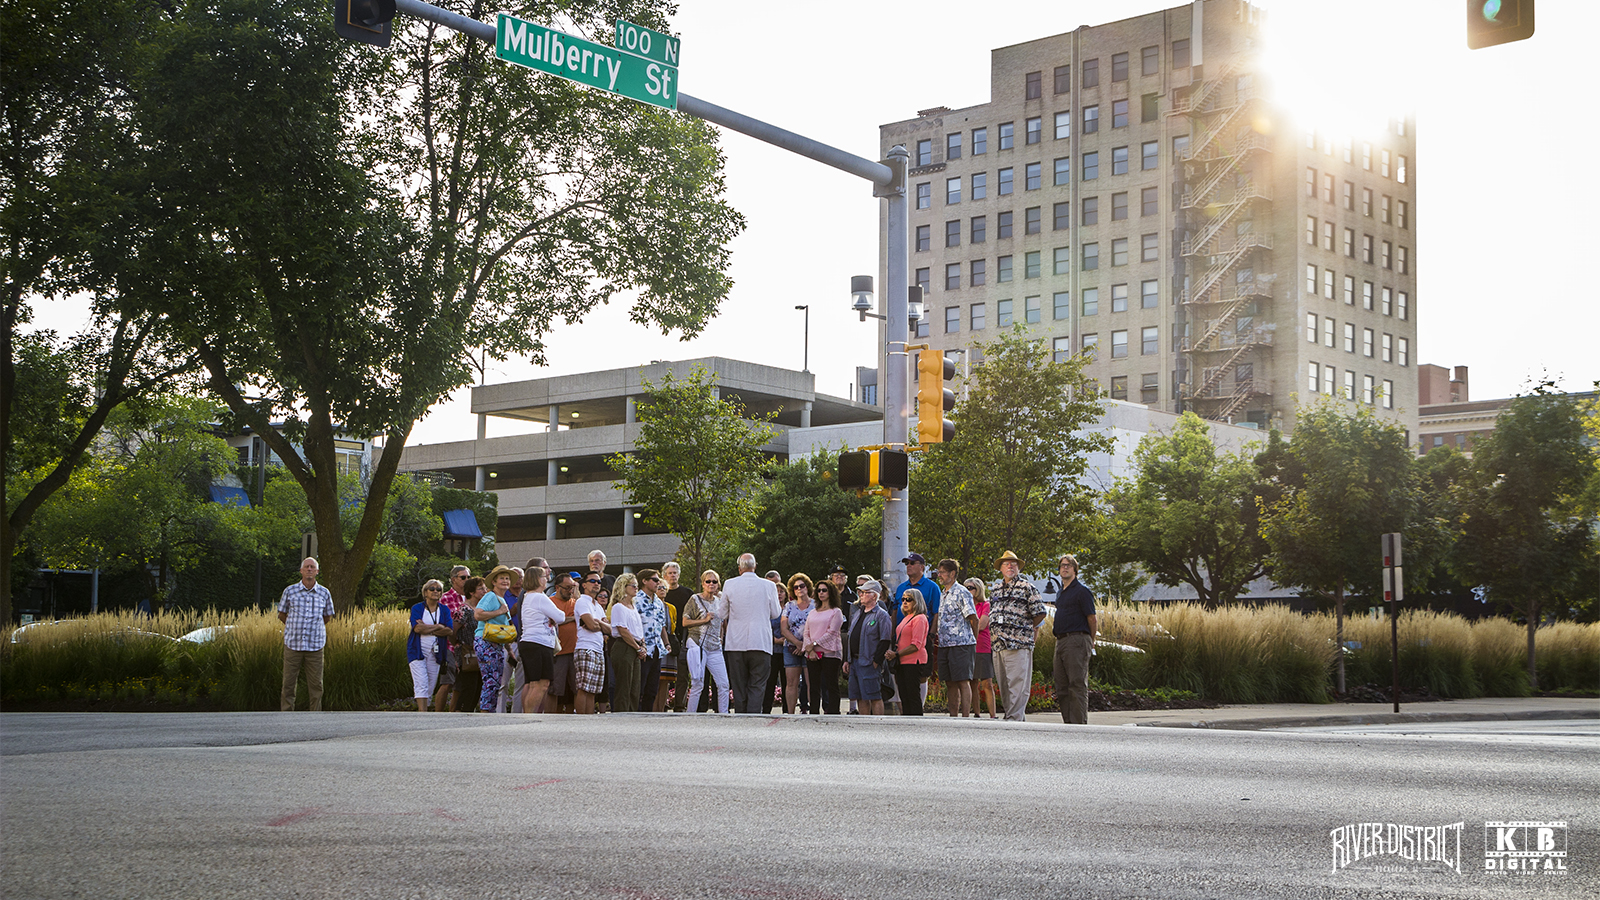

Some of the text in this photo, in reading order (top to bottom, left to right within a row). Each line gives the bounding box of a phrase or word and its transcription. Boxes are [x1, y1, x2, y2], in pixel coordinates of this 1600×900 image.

[504, 17, 671, 100] Mulberry St
[619, 23, 678, 64] 100 N
